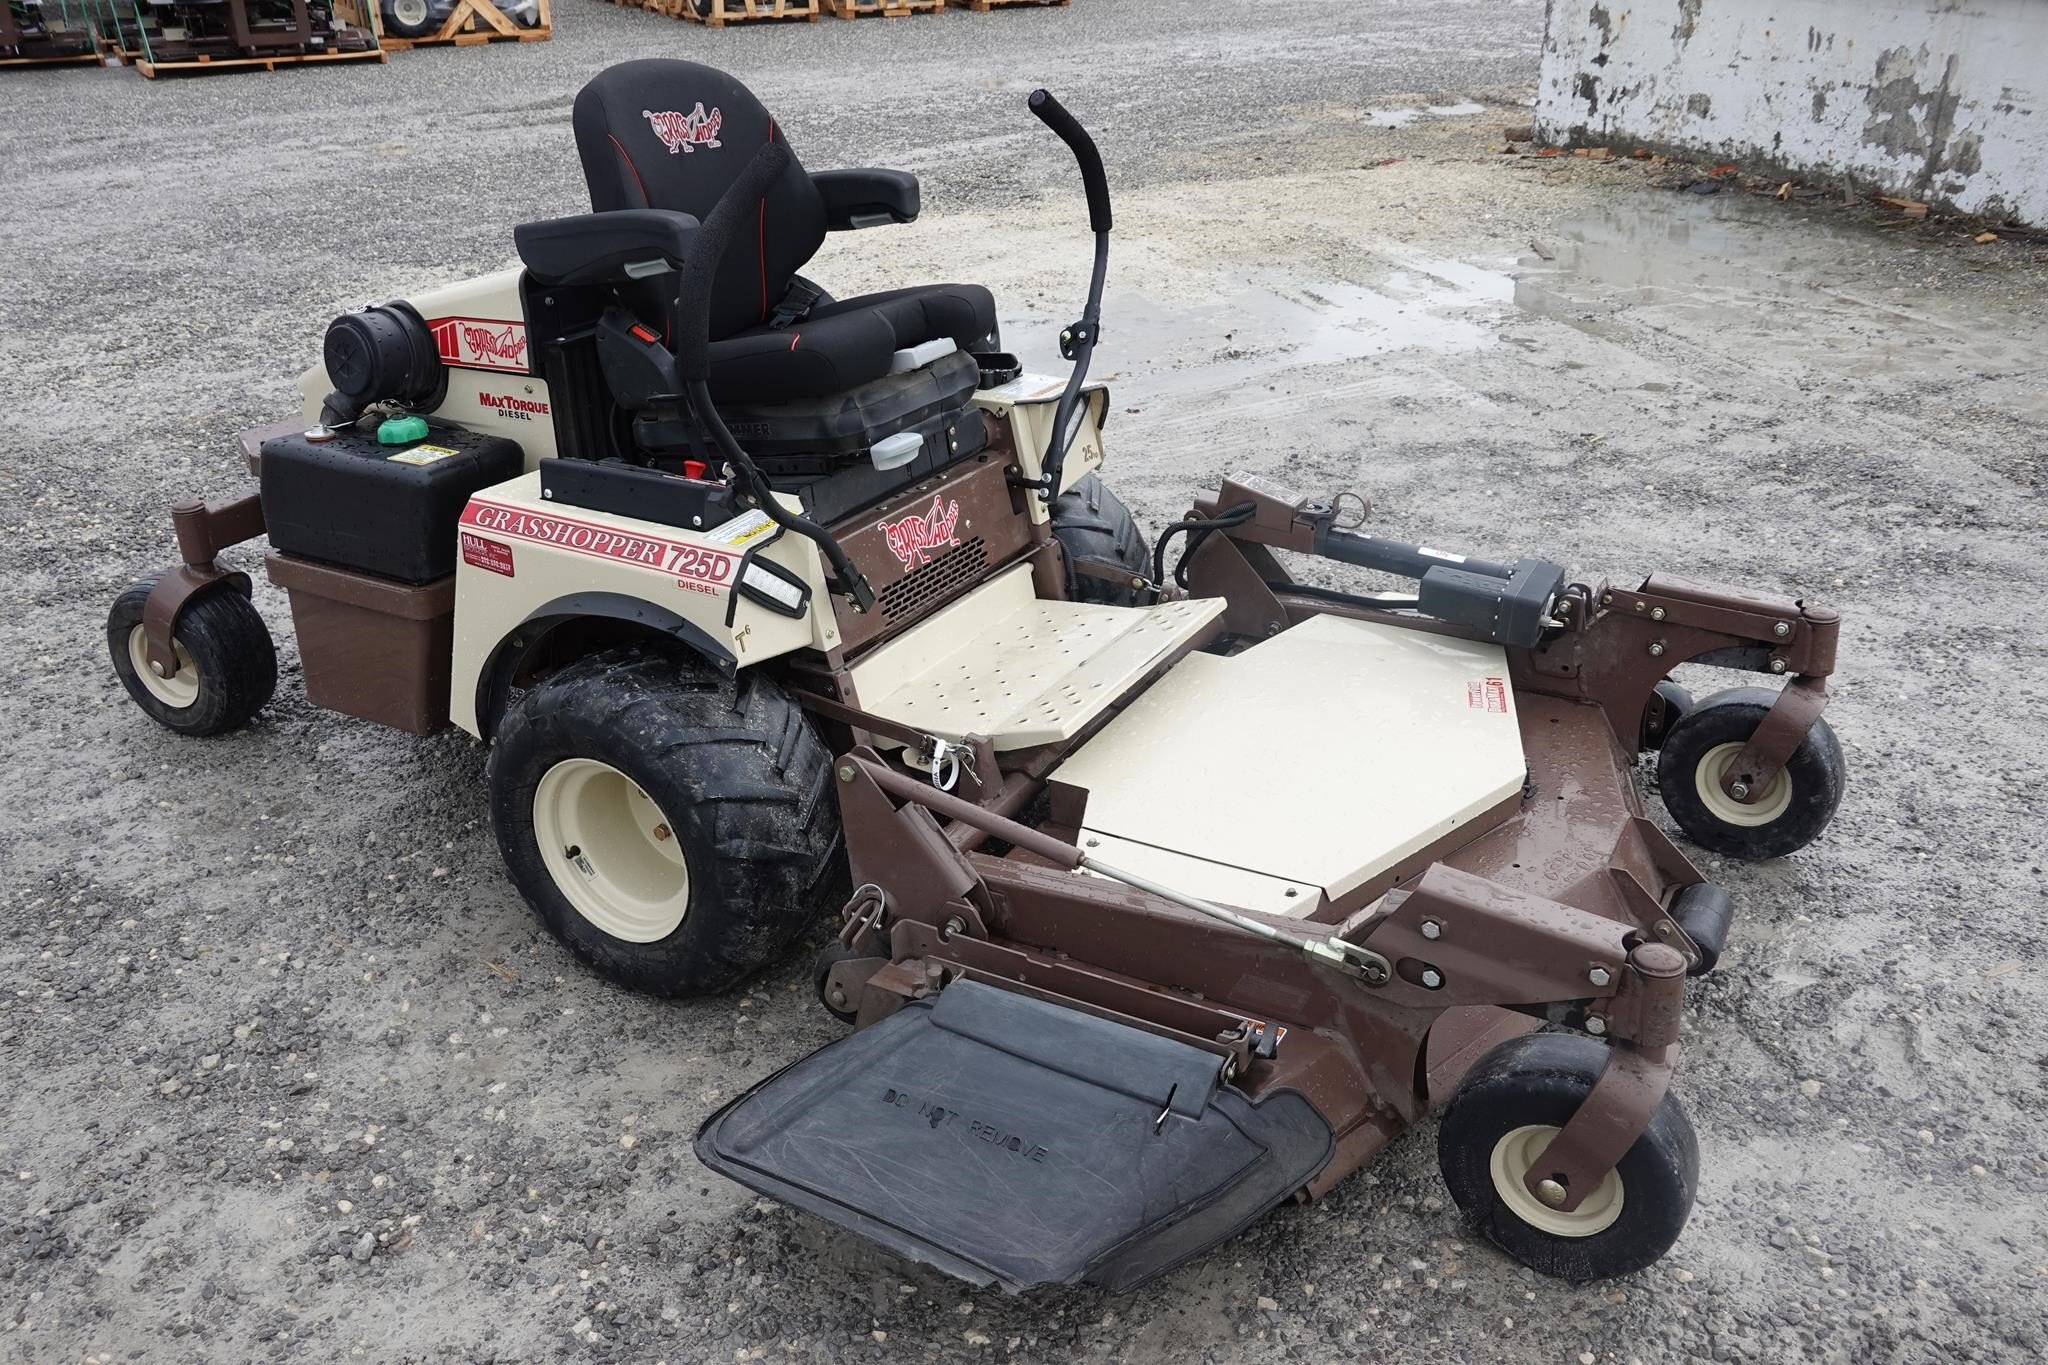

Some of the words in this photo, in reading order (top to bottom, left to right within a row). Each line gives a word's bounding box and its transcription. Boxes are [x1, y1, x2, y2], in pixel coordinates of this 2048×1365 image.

[498, 408, 533, 421] DIESEL
[462, 533, 487, 550] HULL
[475, 506, 661, 568] GRASSHOPPER
[666, 544, 731, 582] 725D
[676, 579, 719, 597] DIESEL
[880, 1087, 911, 1108] DO
[917, 1101, 961, 1128] NOT
[968, 1119, 1050, 1164] REMOVE
